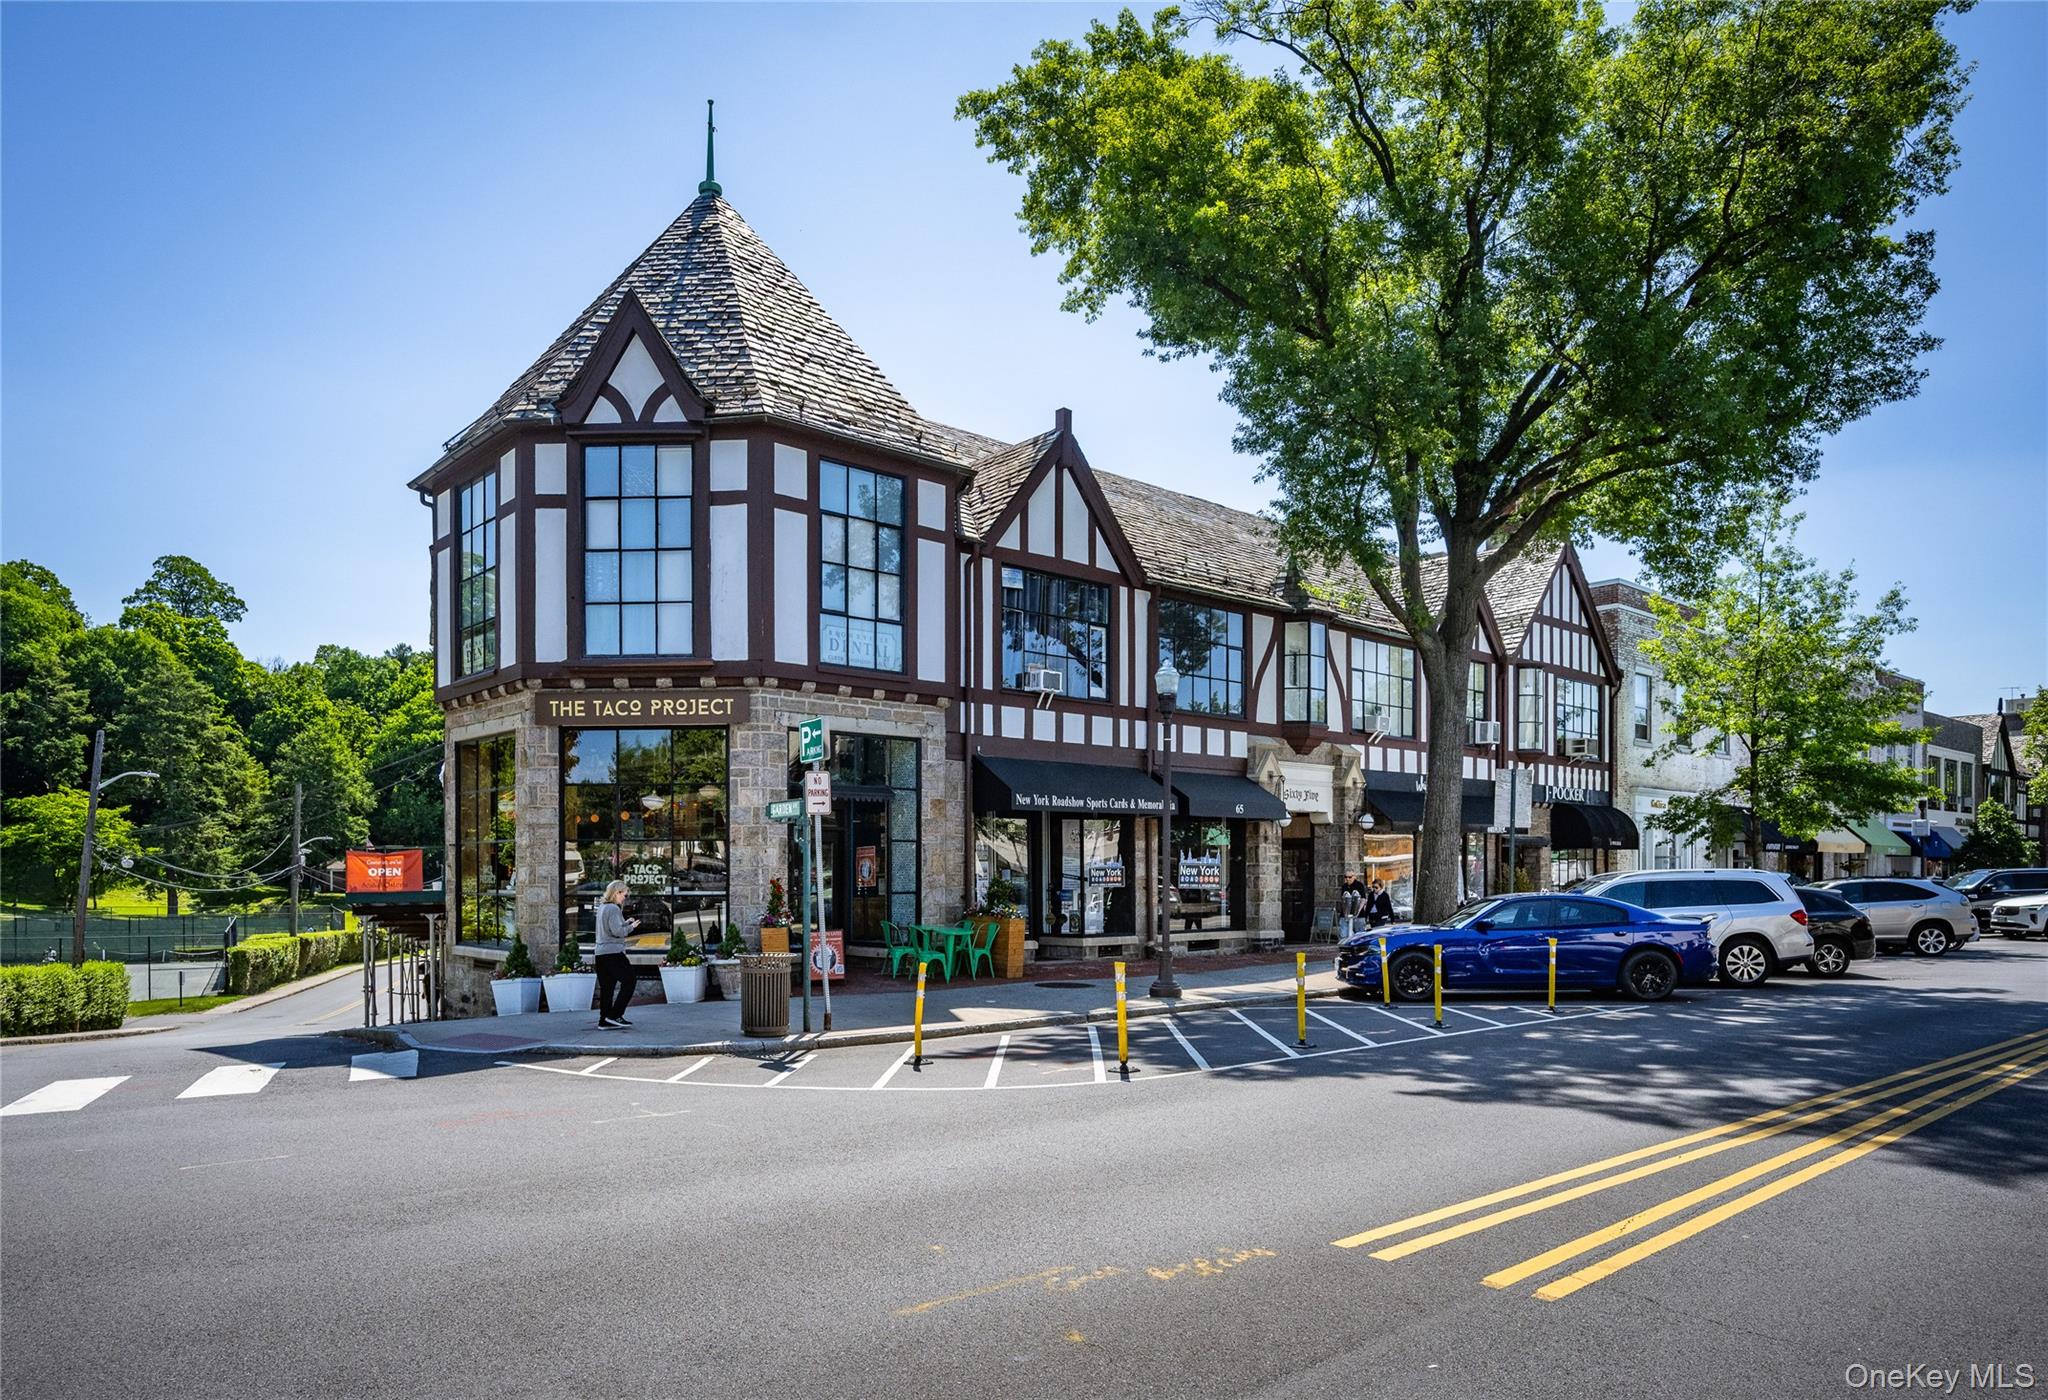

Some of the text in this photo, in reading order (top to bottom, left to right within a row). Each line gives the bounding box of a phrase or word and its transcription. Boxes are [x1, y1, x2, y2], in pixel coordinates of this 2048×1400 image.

[549, 698, 734, 717] THE TACO PROJECT
[813, 777, 822, 785] NO
[808, 788, 828, 797] PARKING
[1283, 788, 1319, 802] Sixty Five
[1016, 793, 1031, 806] New
[1033, 793, 1050, 806] York
[1052, 794, 1084, 808] Roadshow
[1086, 796, 1108, 811] Sports
[1109, 797, 1129, 809] Cards
[1130, 798, 1136, 809] &
[1235, 803, 1244, 814] 65
[367, 867, 402, 877] OPEN
[632, 864, 660, 875] TACO
[1091, 868, 1122, 877] New York
[1180, 865, 1220, 876] New York
[623, 874, 668, 885] PROJECT
